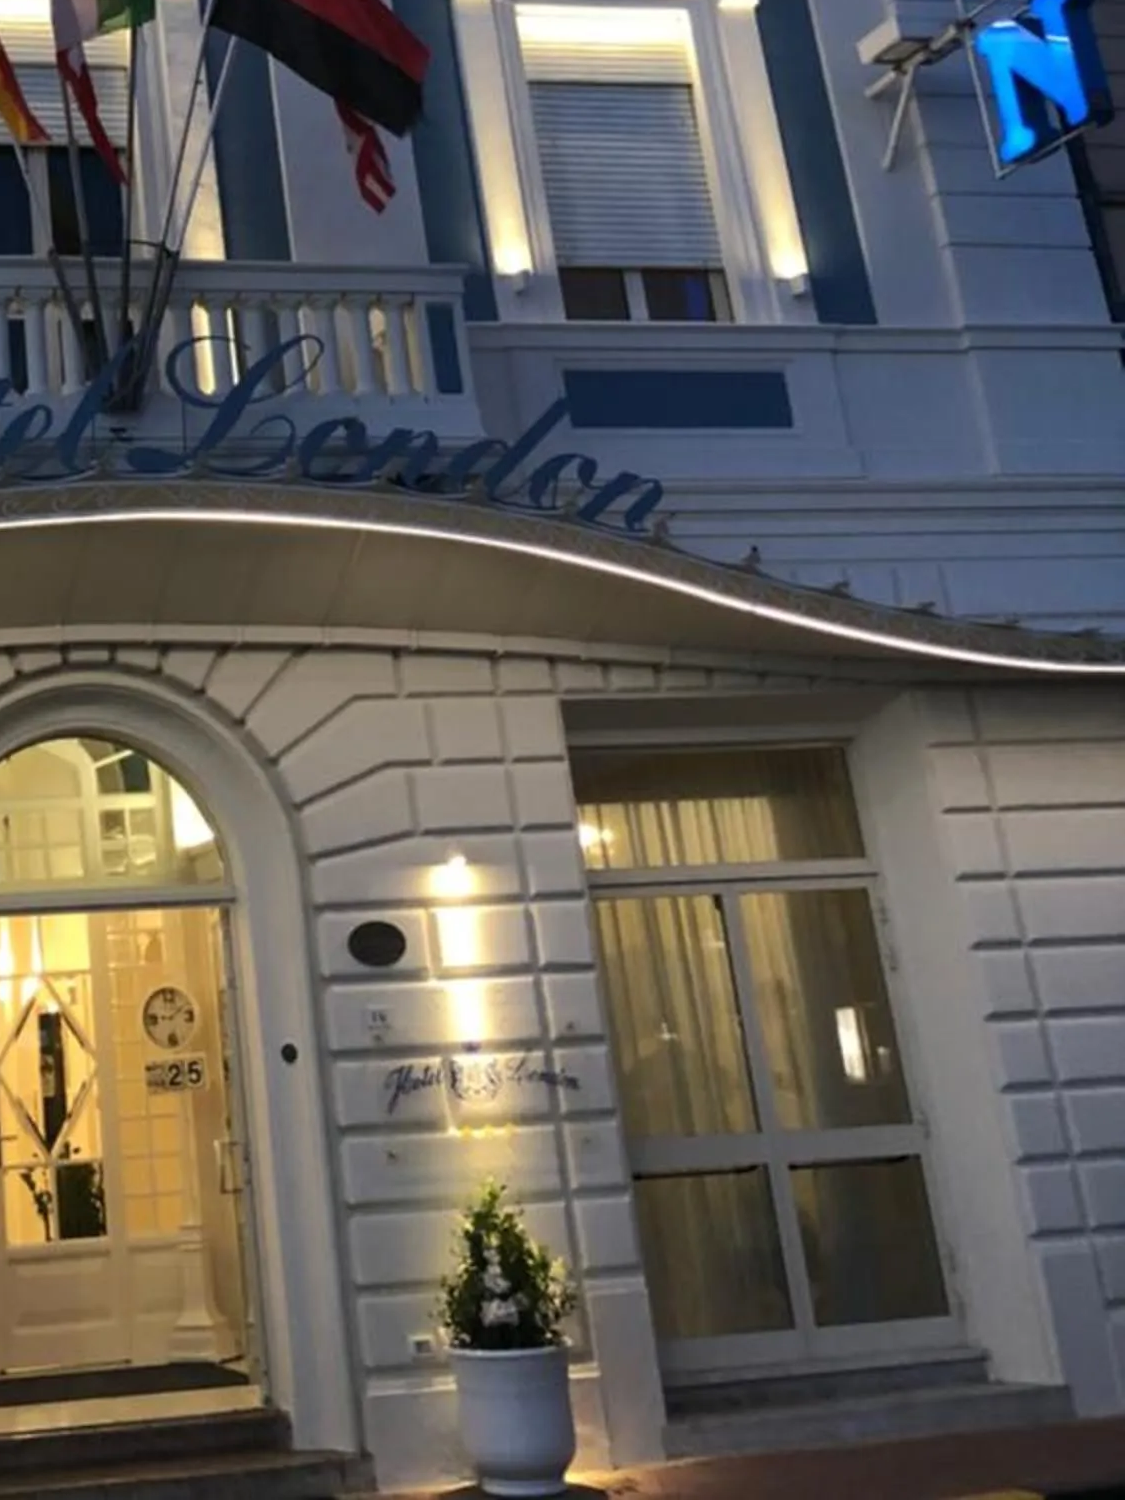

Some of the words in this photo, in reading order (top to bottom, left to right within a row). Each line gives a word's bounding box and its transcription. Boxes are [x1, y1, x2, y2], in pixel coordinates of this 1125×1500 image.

[127, 334, 664, 534] London
[183, 1008, 195, 1024] 3
[168, 1061, 202, 1087] 25
